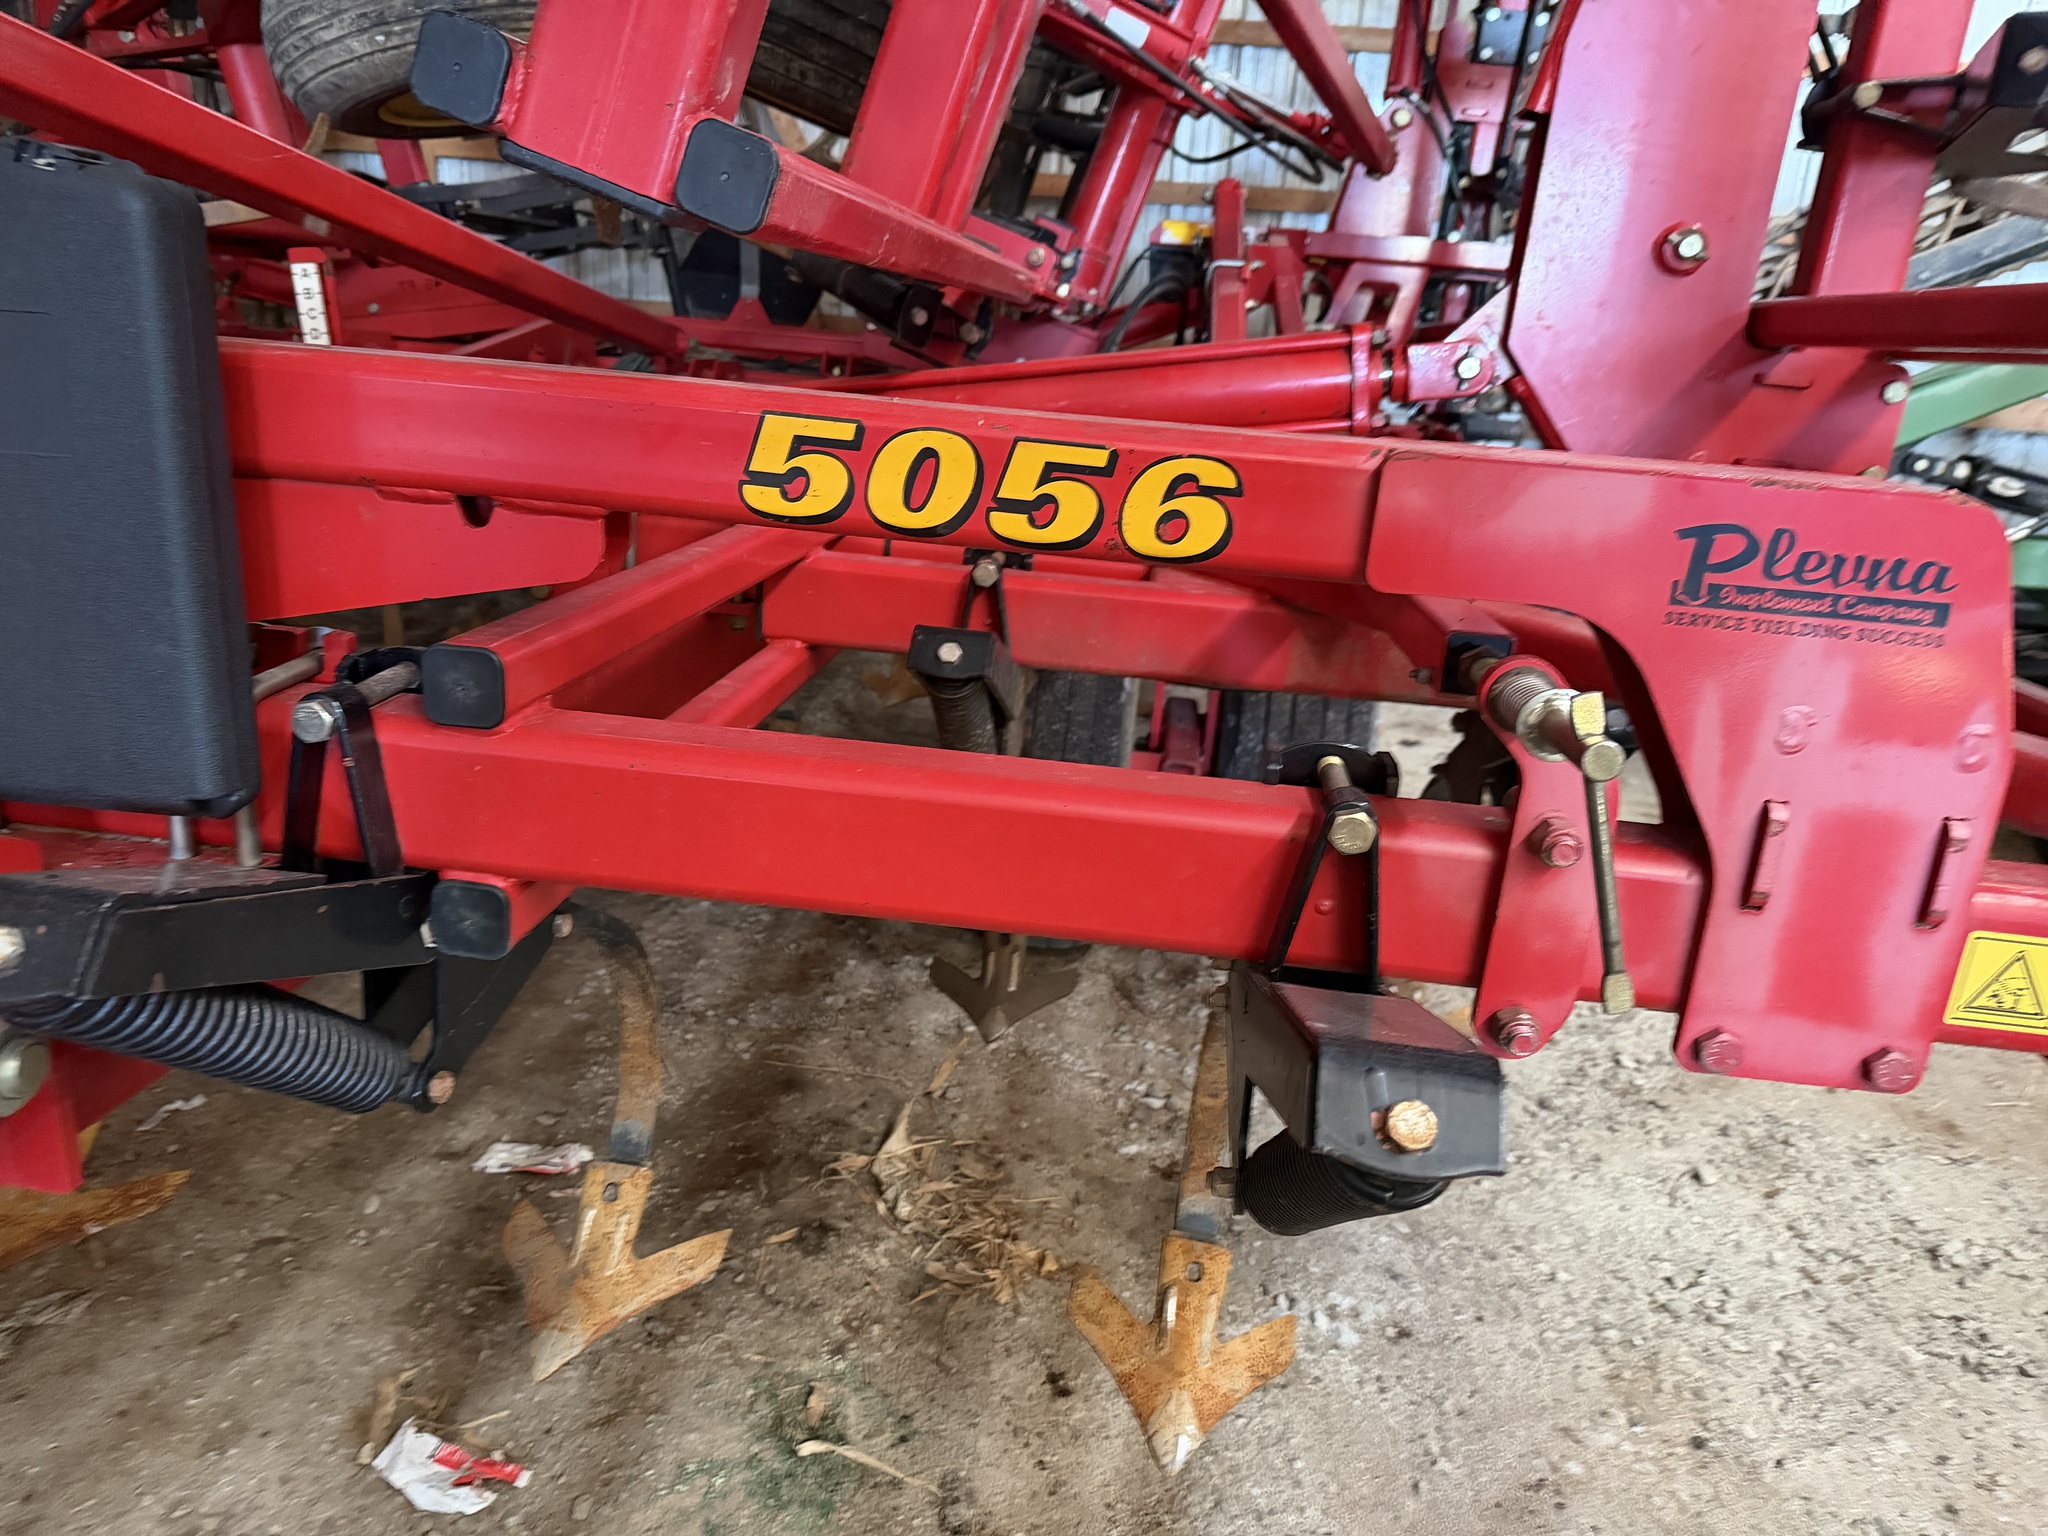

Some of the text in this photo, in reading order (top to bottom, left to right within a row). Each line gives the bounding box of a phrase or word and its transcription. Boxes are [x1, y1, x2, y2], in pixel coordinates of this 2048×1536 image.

[306, 307, 317, 320] C
[738, 410, 1243, 563] 5056
[1673, 523, 1959, 604] Plevna
[1661, 611, 1946, 648] SERVICE YIELDING SUCCESS
[1837, 596, 1937, 626] Company
